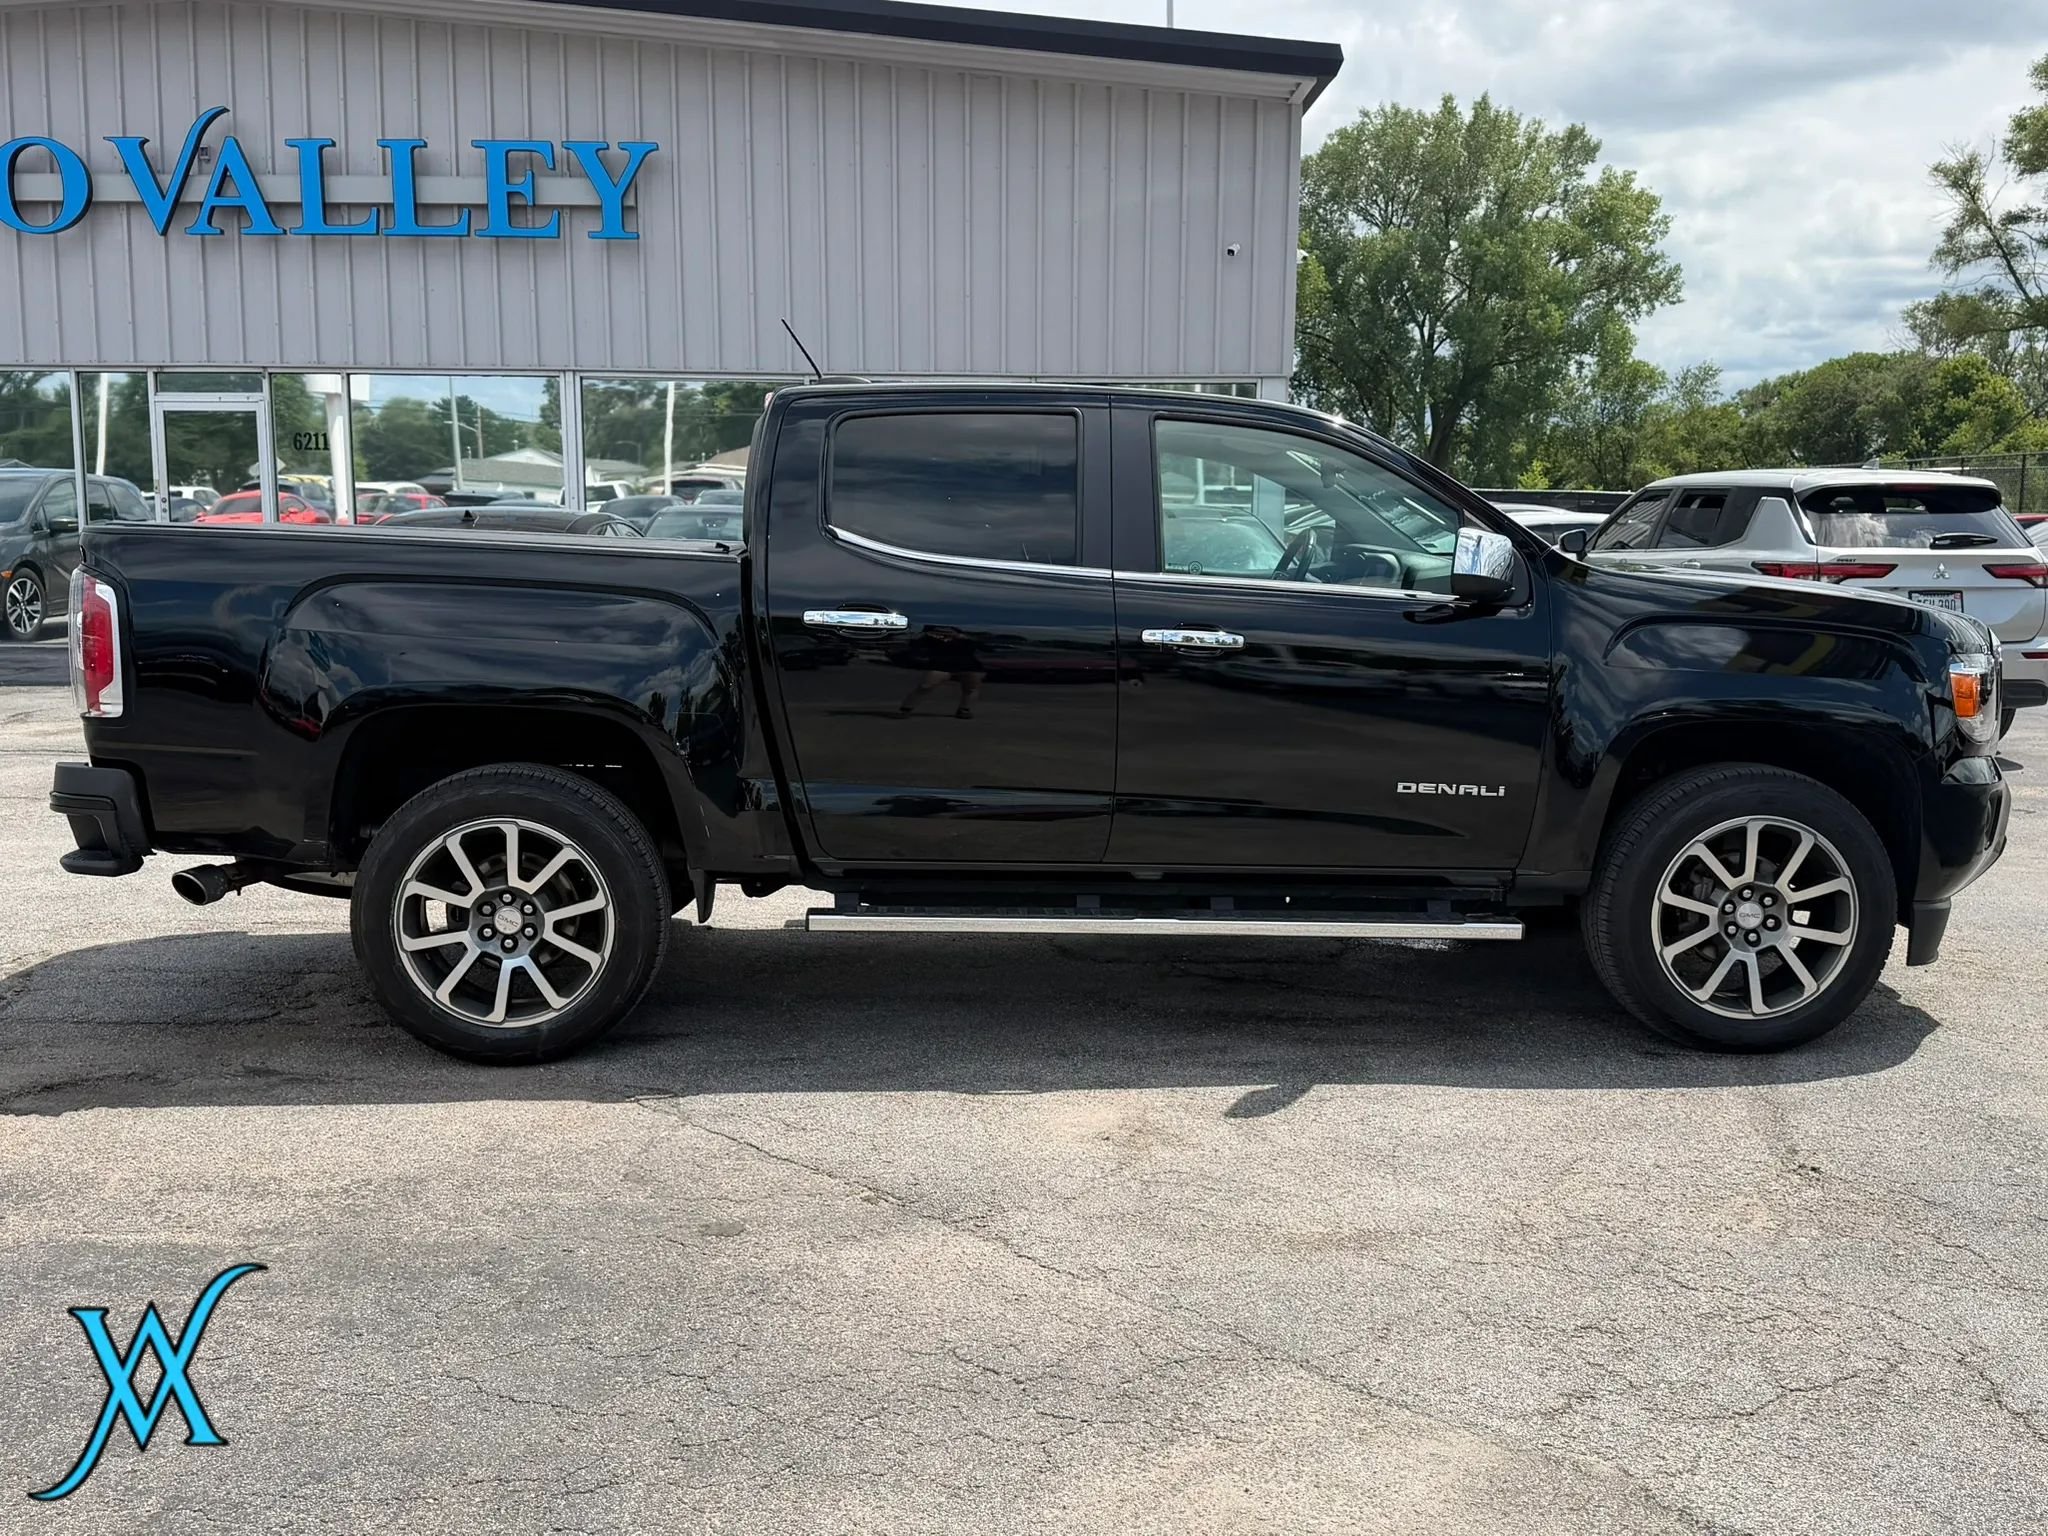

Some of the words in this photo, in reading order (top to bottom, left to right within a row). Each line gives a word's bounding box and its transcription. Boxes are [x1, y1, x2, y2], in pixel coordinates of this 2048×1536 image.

[0, 136, 93, 235] O
[103, 106, 660, 240] VALLEY
[293, 432, 330, 451] 6211
[1396, 782, 1506, 797] DENALI
[497, 914, 520, 928] GMC
